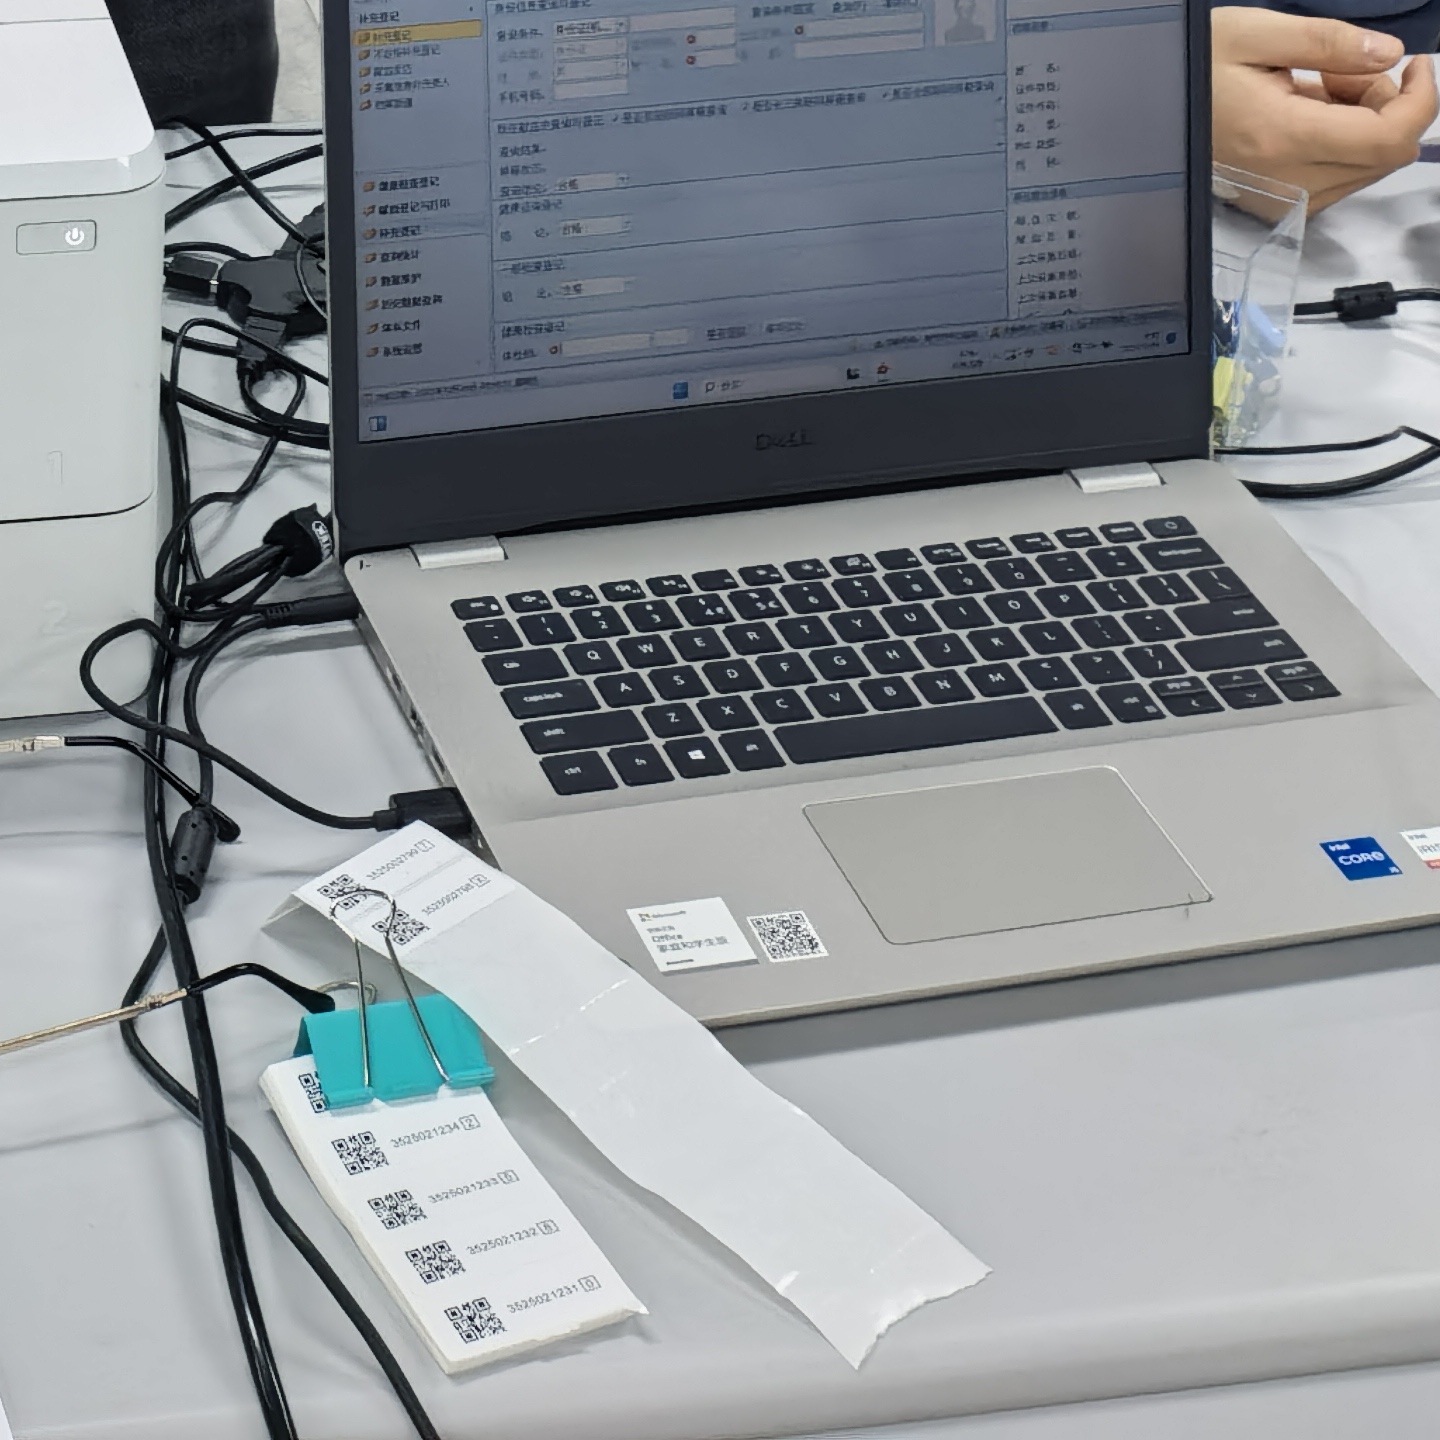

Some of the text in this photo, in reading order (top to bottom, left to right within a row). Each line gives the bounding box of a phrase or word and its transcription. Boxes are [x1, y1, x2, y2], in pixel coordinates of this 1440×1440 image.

[587, 649, 603, 661] Q
[637, 641, 655, 655] W
[693, 636, 707, 648] E
[747, 631, 760, 641] R
[799, 624, 810, 634] T
[851, 618, 863, 628] Y
[904, 612, 917, 622] U
[1008, 600, 1021, 610] O
[620, 682, 632, 694] A
[672, 674, 686, 687] S
[726, 668, 739, 680] D
[780, 661, 791, 673] F
[833, 655, 847, 667] G
[886, 648, 900, 661] H
[942, 642, 951, 654] J
[669, 712, 681, 723] Z
[721, 705, 735, 717] X
[776, 697, 789, 709] C
[828, 691, 841, 703] V
[989, 671, 1005, 683] M
[652, 933, 683, 942] Office
[656, 935, 729, 953] 家庭和学生版
